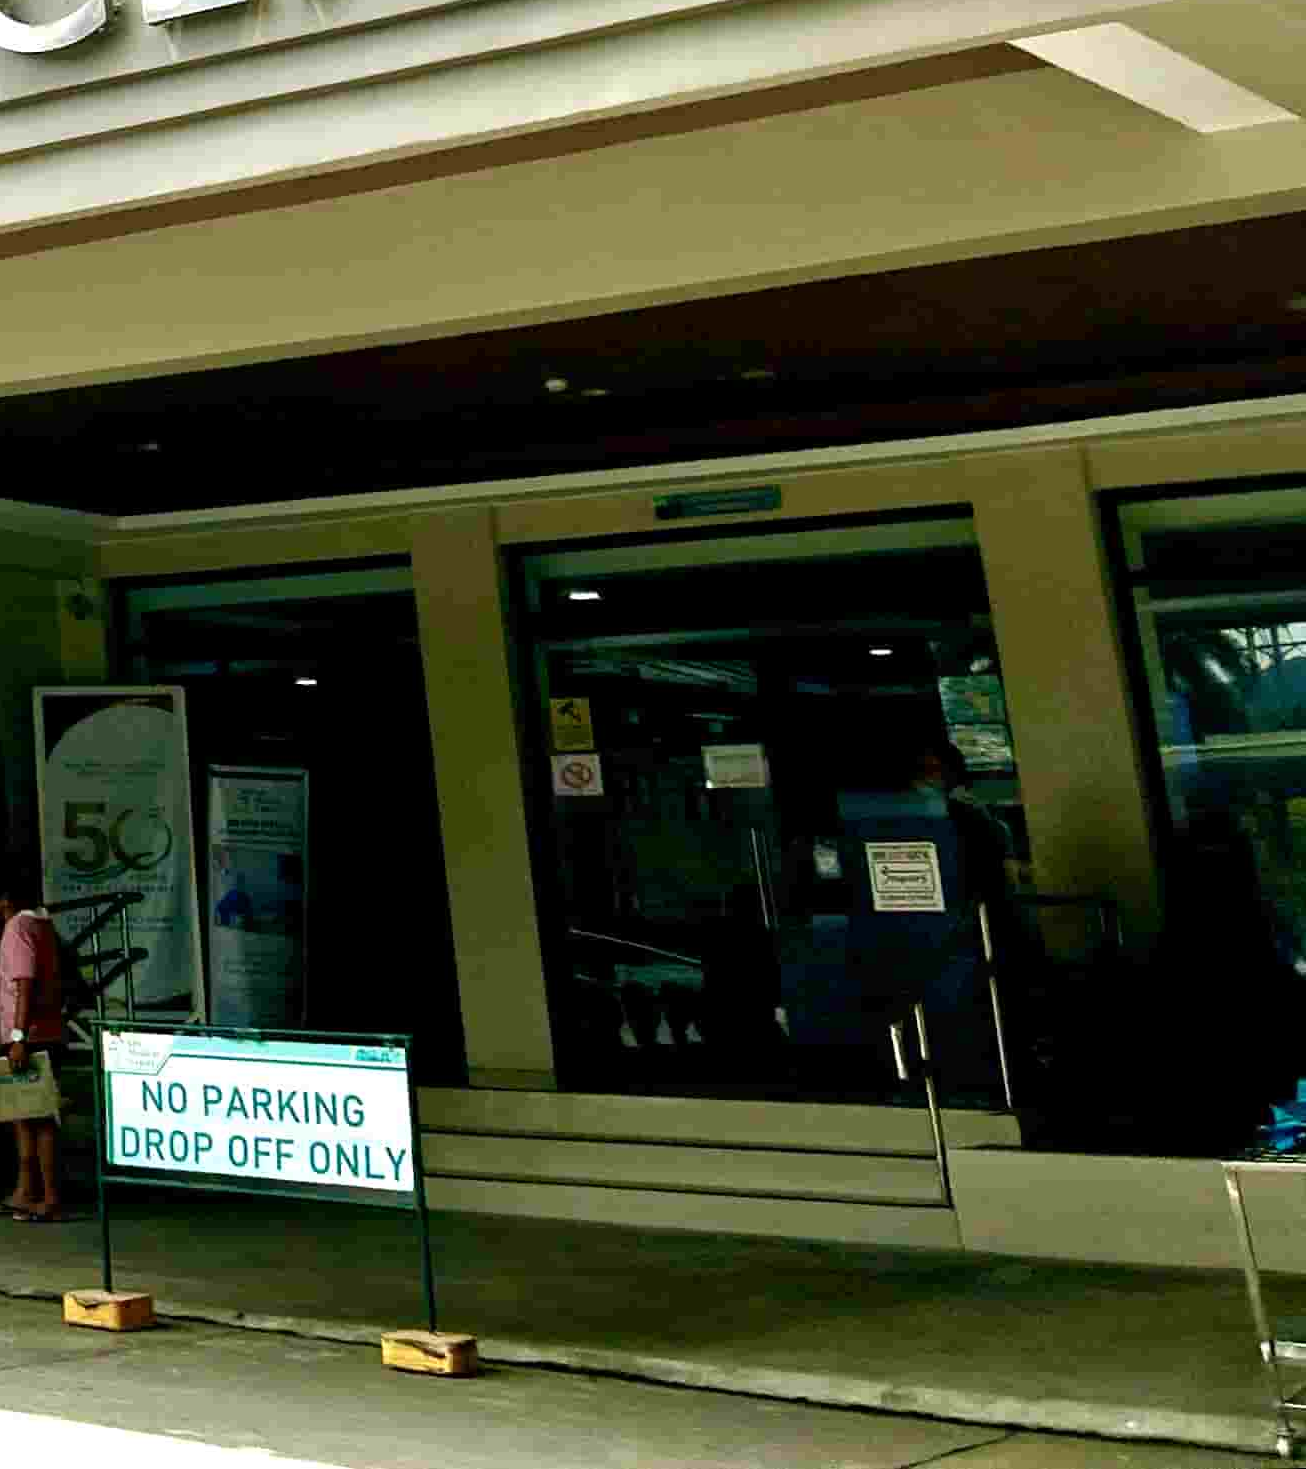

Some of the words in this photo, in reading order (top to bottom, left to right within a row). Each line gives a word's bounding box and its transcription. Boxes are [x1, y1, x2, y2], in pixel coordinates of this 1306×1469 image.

[140, 1080, 189, 1115] NO
[202, 1083, 366, 1128] PARKING
[119, 1125, 214, 1165] DROP
[227, 1134, 295, 1171] OFF
[309, 1140, 407, 1181] ONLY
